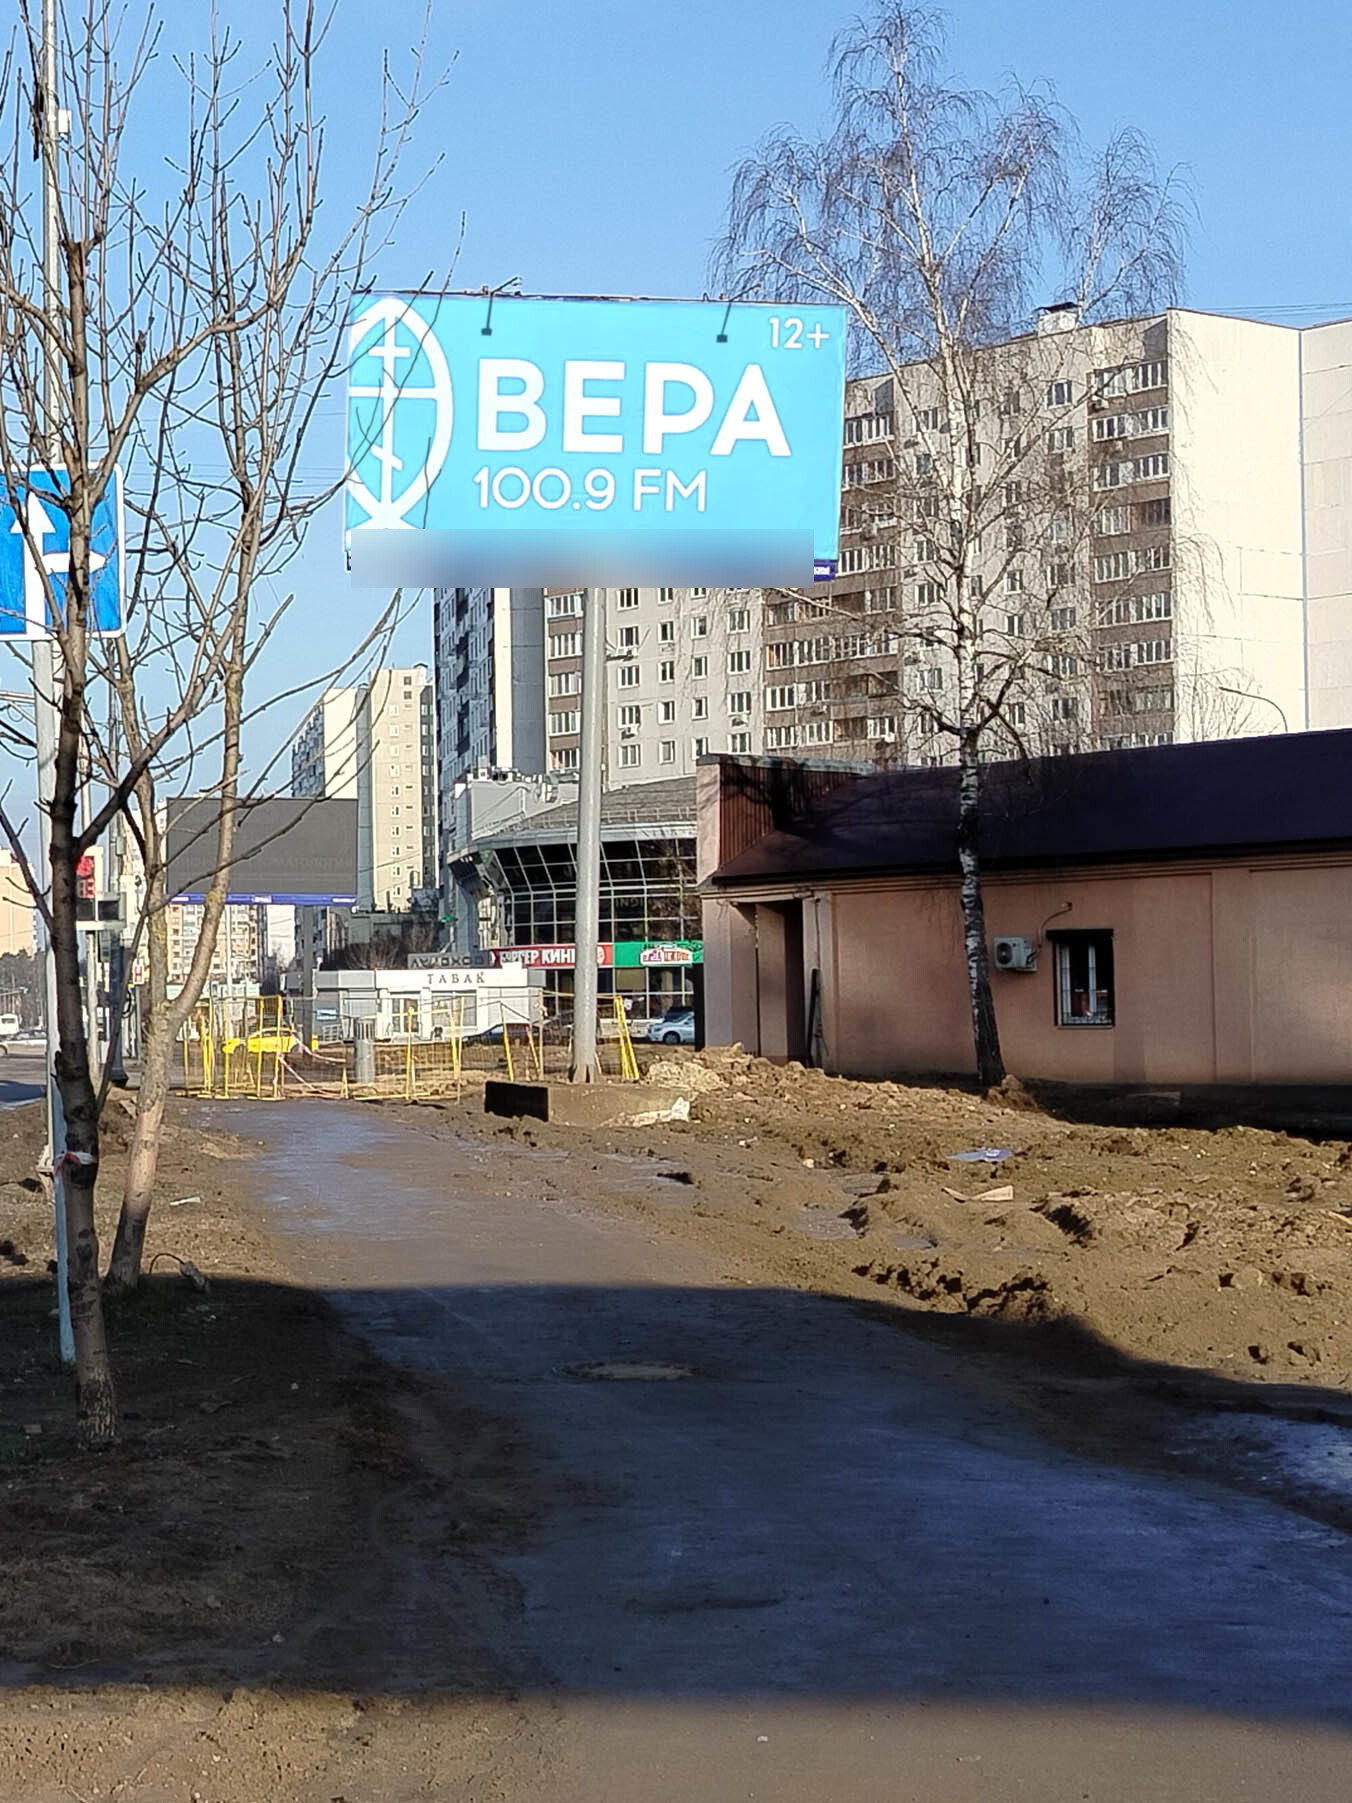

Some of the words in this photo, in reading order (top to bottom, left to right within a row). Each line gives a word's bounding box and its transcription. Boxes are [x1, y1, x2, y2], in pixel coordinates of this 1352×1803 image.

[768, 317, 830, 349] 12+
[477, 358, 792, 457] ВЕРА
[473, 466, 616, 511] 100.9
[633, 469, 708, 513] FM
[428, 972, 485, 985] ТАБАК
